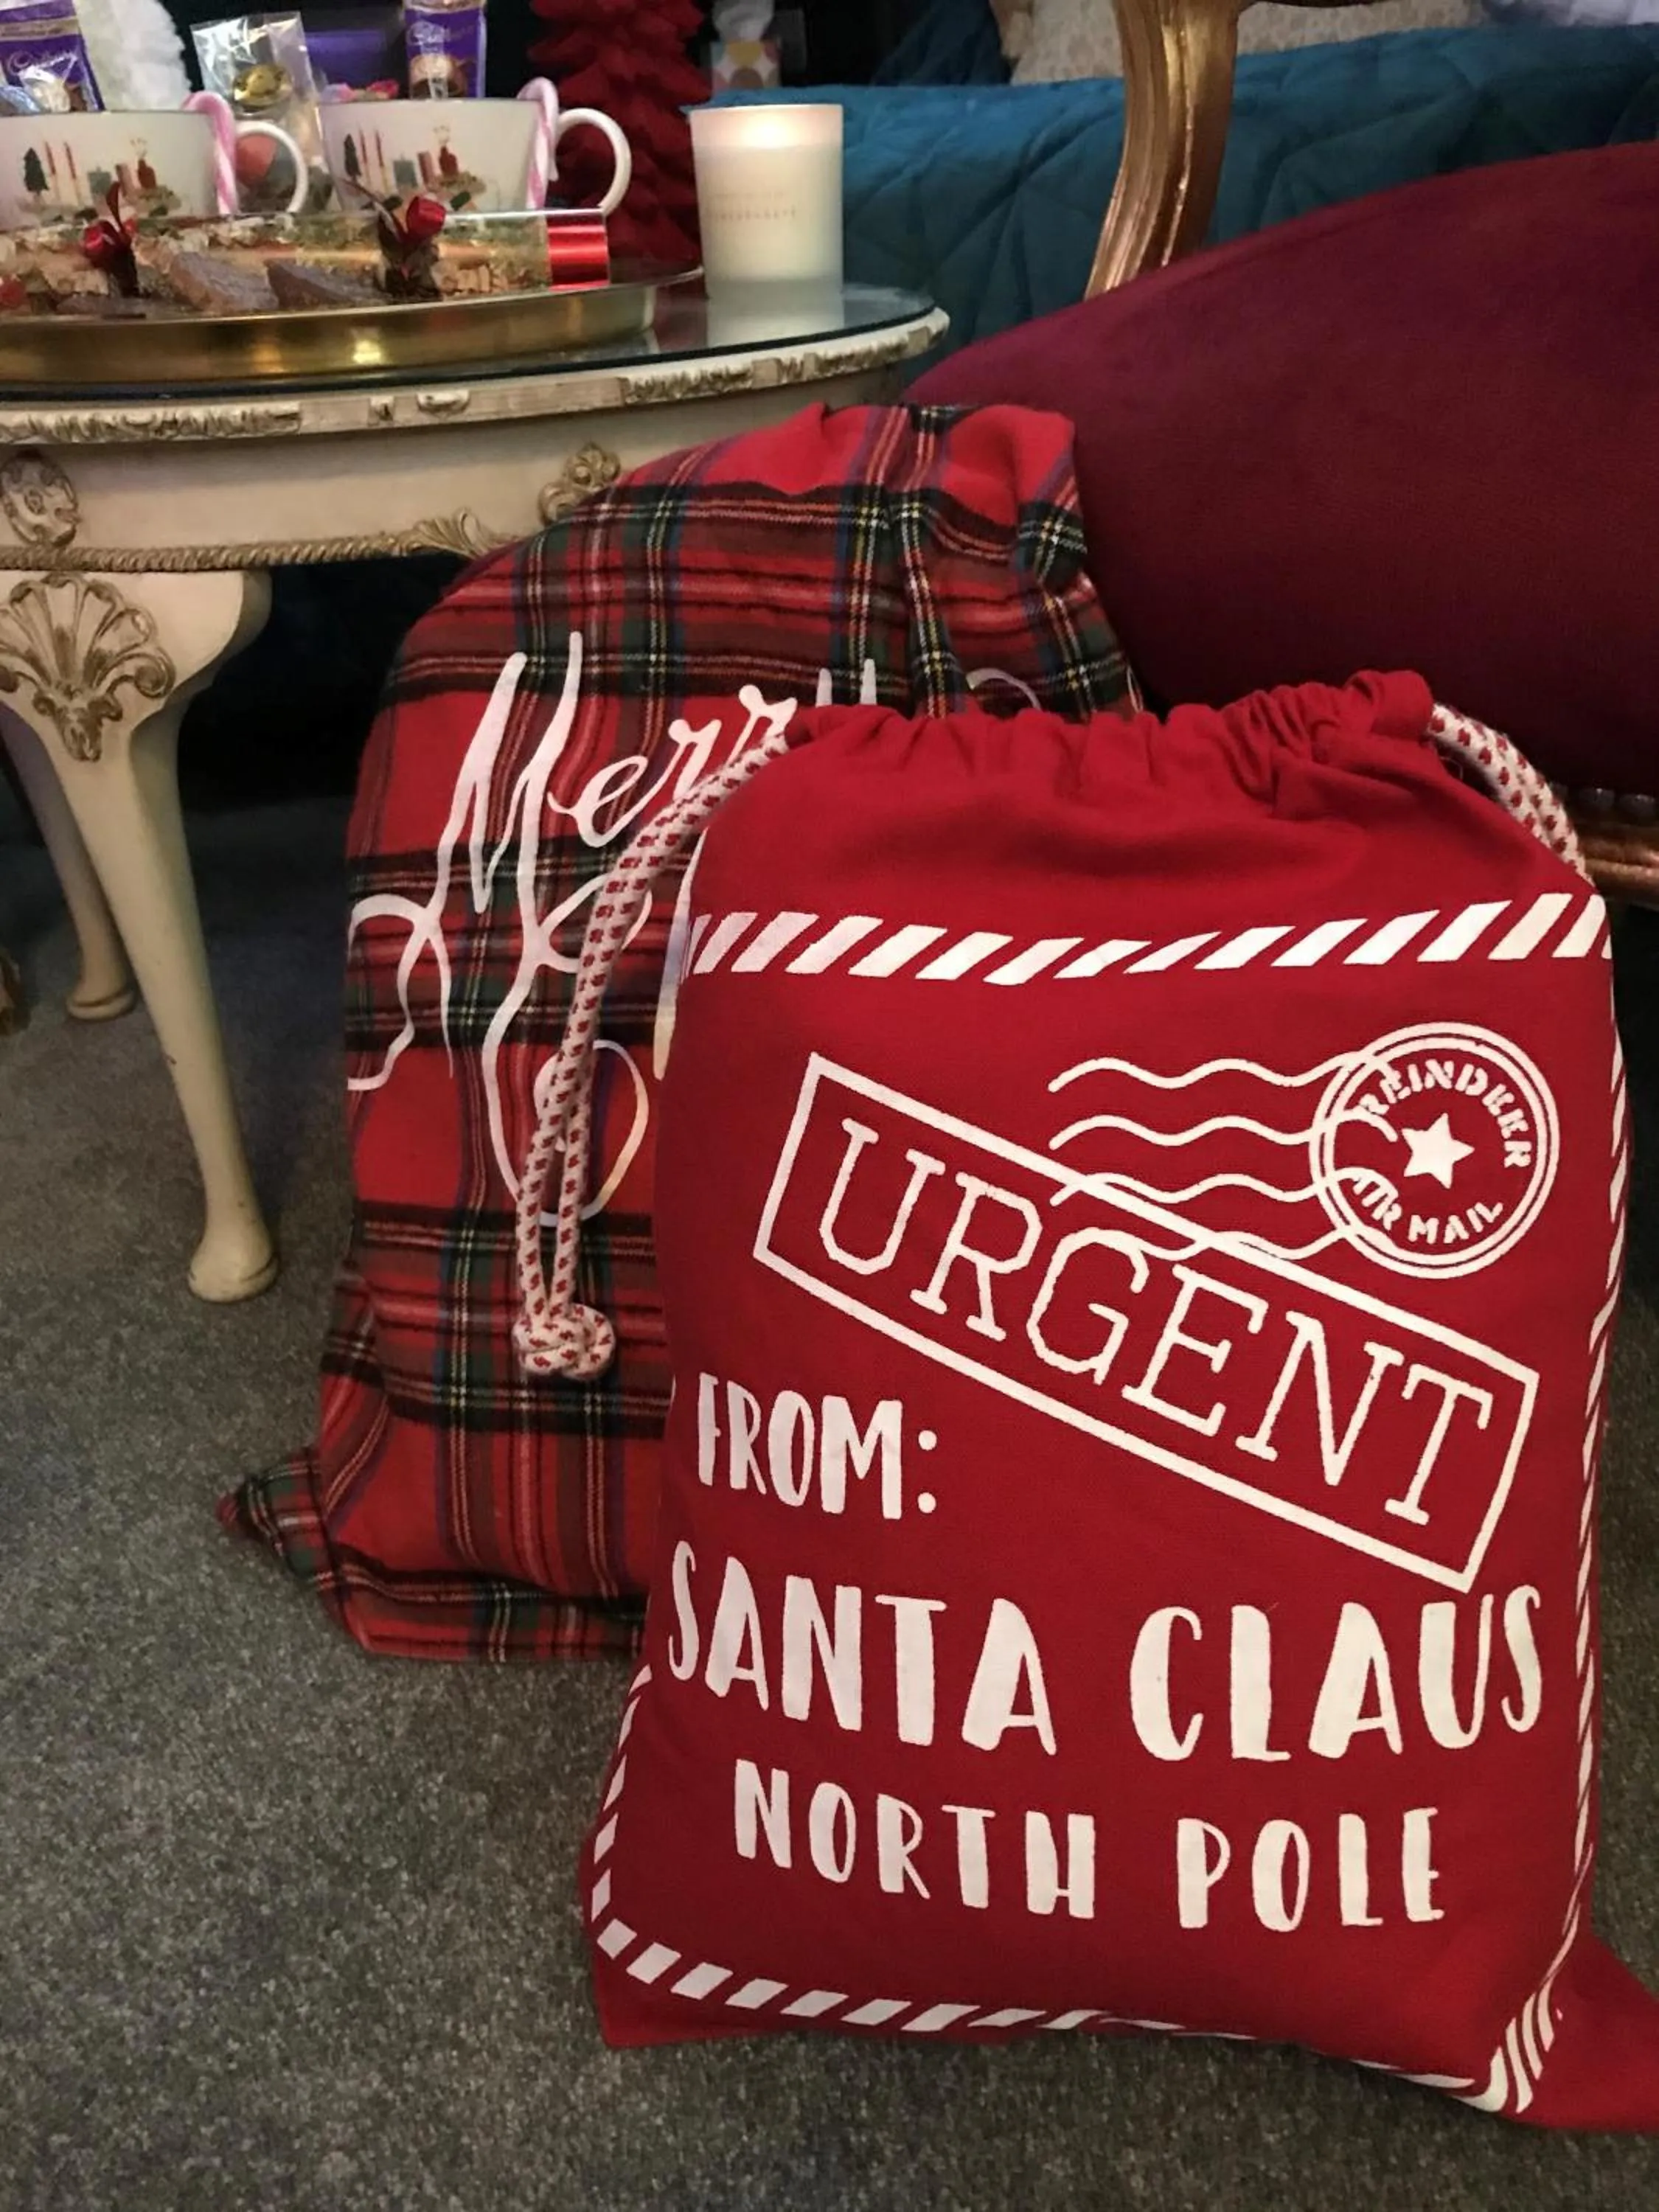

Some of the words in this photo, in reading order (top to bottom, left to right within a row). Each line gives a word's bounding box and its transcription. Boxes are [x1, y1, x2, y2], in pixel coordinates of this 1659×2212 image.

[348, 630, 877, 1091] Merr
[1356, 1059, 1533, 1169] REINDEER
[1408, 1201, 1504, 1245] MAIL
[818, 1117, 1493, 1526] URGENT
[698, 1372, 938, 1520] FROM:
[668, 1540, 1057, 1756] SANTA
[1130, 1585, 1543, 1761] CLAUS
[734, 1759, 1096, 1919] NORTH
[1177, 1807, 1444, 1932] POLE
